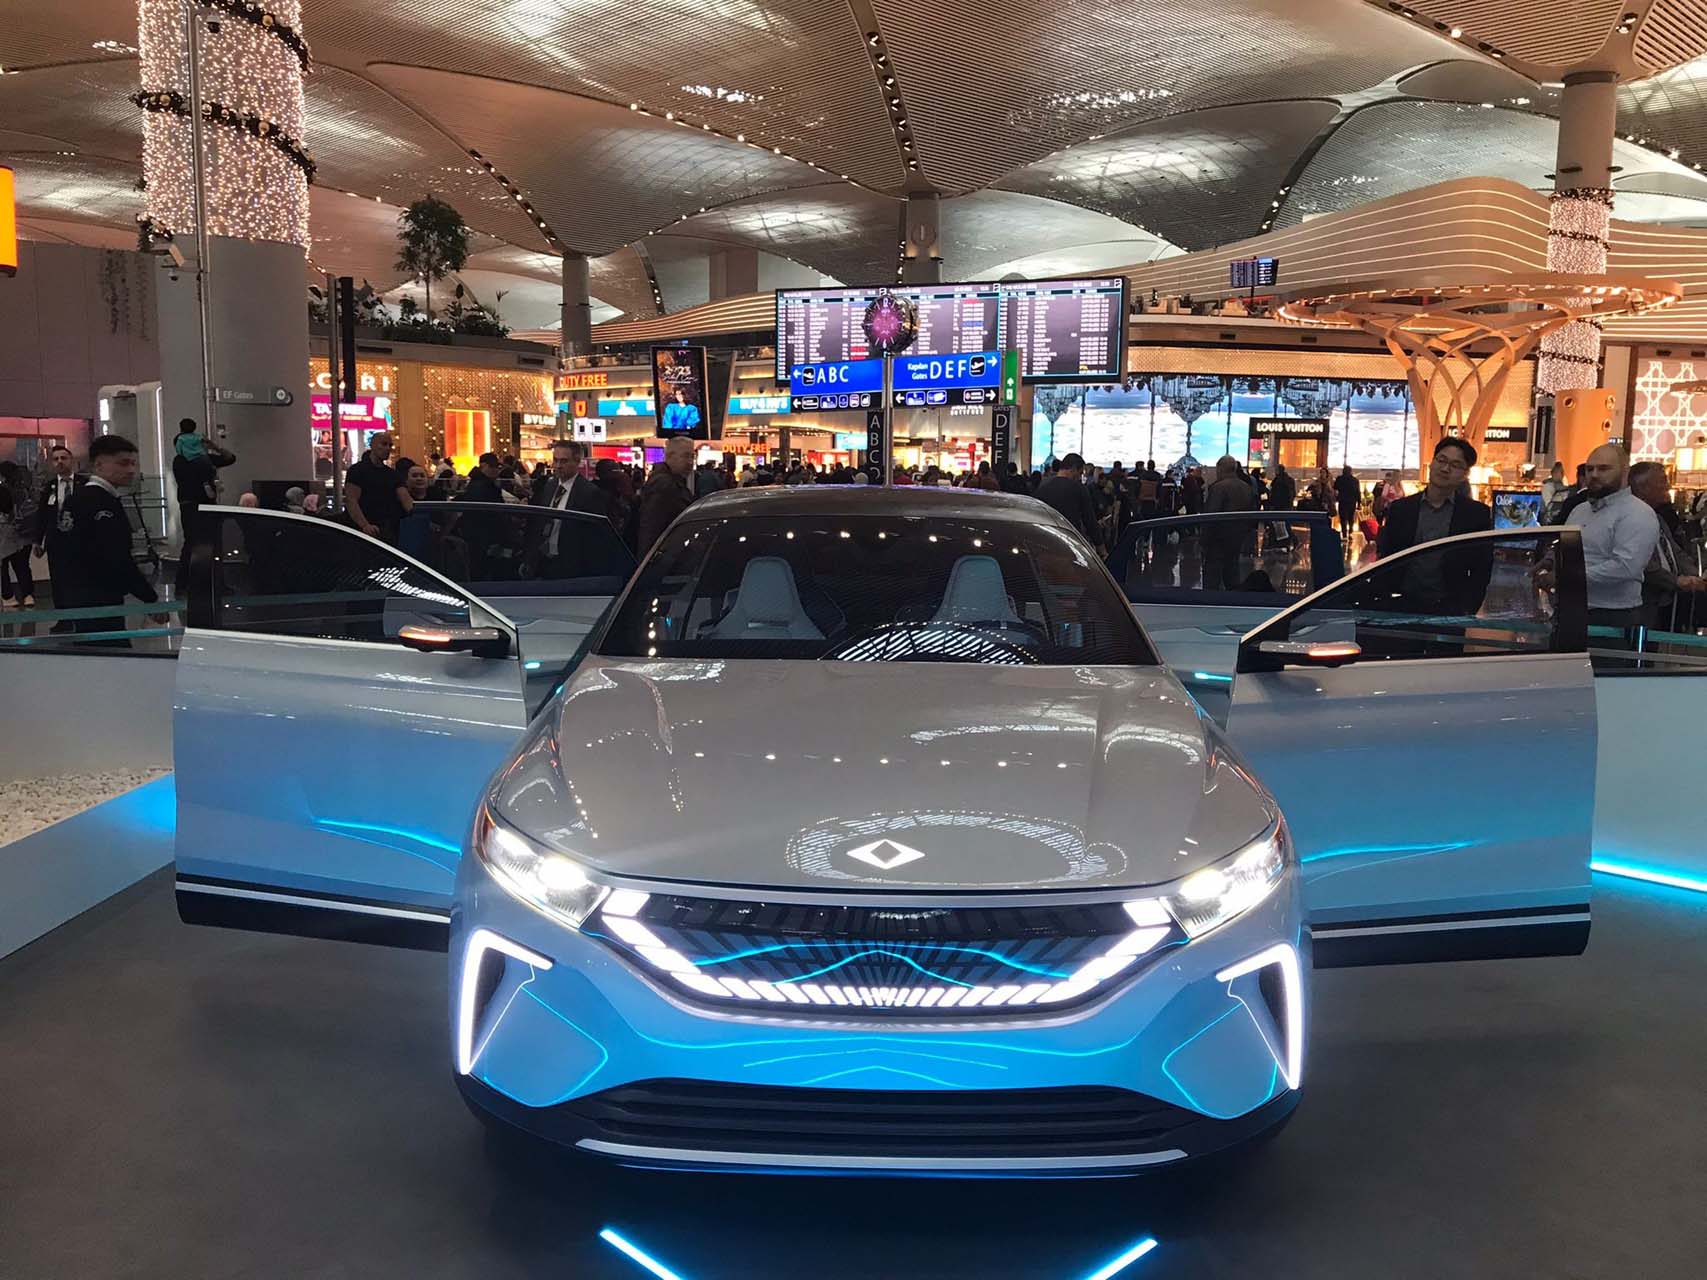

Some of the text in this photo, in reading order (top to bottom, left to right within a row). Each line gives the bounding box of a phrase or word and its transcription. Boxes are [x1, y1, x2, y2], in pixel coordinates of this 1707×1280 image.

[560, 373, 608, 388] DUTY FREE
[816, 365, 849, 384] ABC
[1256, 422, 1324, 433] LOUIS VUITTON
[722, 443, 749, 453] DUTY
